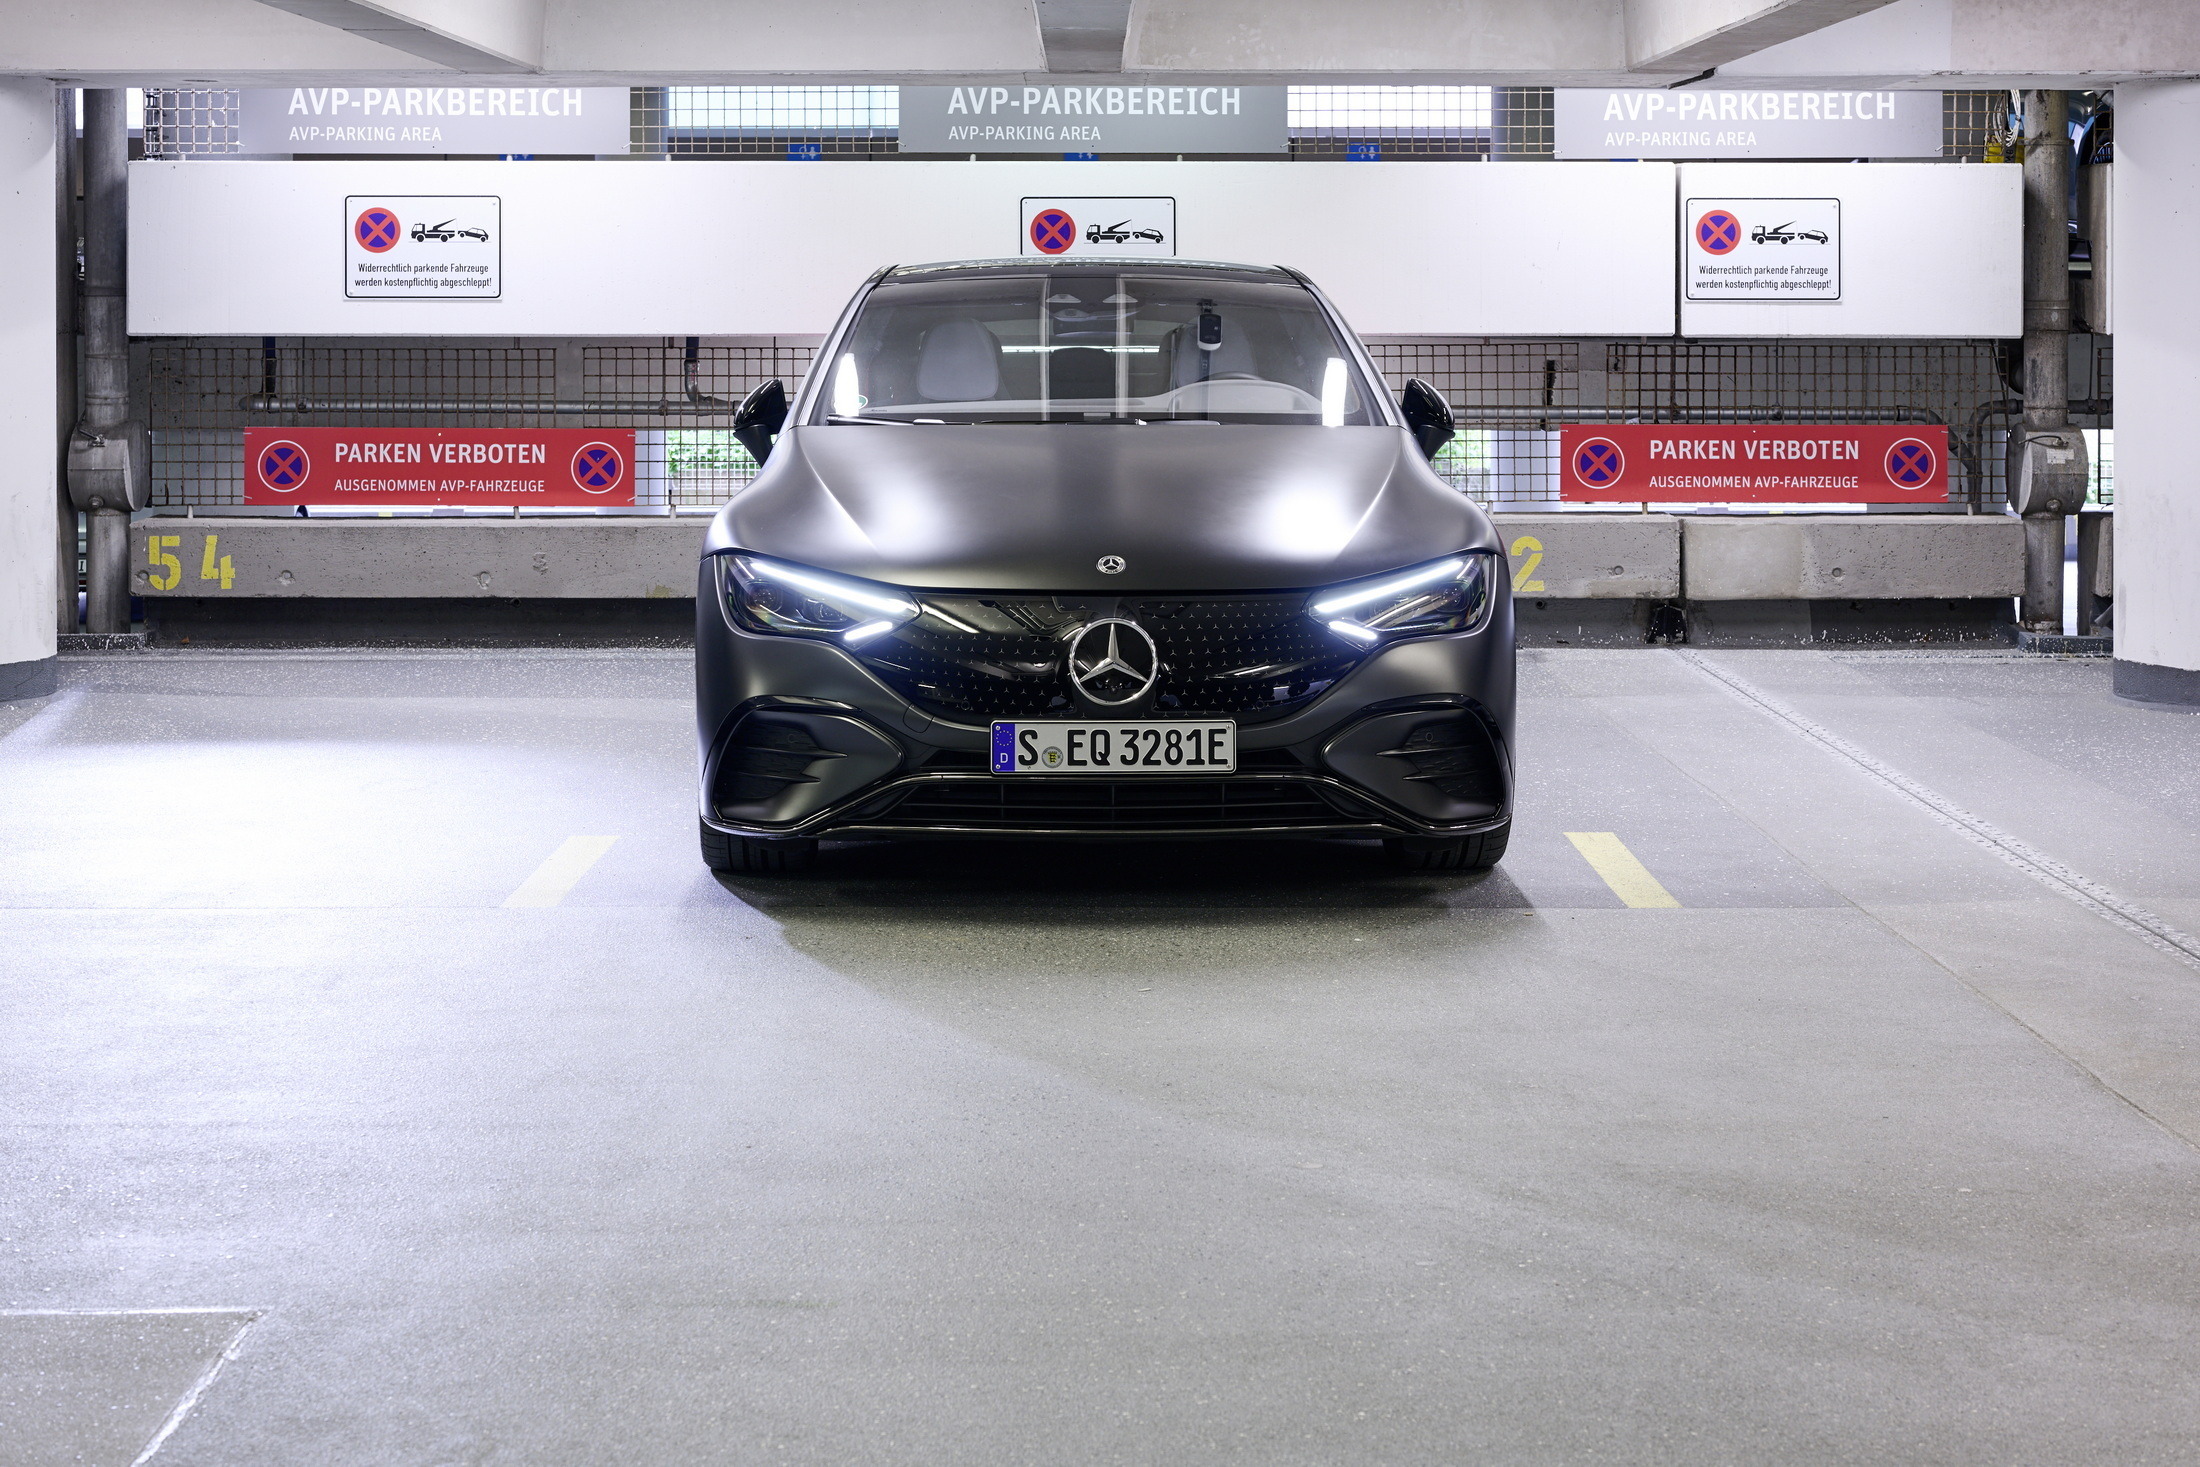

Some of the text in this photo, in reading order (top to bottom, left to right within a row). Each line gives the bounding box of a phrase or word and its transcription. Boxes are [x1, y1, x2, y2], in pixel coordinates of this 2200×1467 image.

[288, 88, 583, 117] AVP-PARKBEREICH
[947, 87, 1241, 116] AVP-PARKBEREICH
[1603, 91, 1896, 121] AVP-PARKBEREICH
[289, 126, 442, 142] AVP-PARKING AREA
[948, 125, 1101, 141] AVP-PARKING AREA
[1604, 131, 1757, 147] AVP-PARKING AREA
[358, 263, 489, 275] Widerrechtlich parkende Fahrzeuge
[1698, 265, 1829, 276] Widerrechtlich parkende Fahrzeuge
[354, 277, 492, 289] werden kostenpflichtig abgeschleppt!
[1695, 279, 1832, 291] werden kostenpflichtig abgeschleppt!
[335, 442, 546, 464] PARKEN VERBOTEN
[1650, 439, 1859, 460] PARKEN VERBOTEN
[334, 478, 545, 492] AUSGENOMMEN AVP-FAHRZEUGE
[1649, 475, 1859, 489] AUSGENOMMEN AVP-FAHRZEUGE
[1017, 729, 1039, 767] S
[1067, 729, 1111, 767] EQ
[1120, 728, 1229, 767] 3281E
[999, 752, 1009, 764] D
